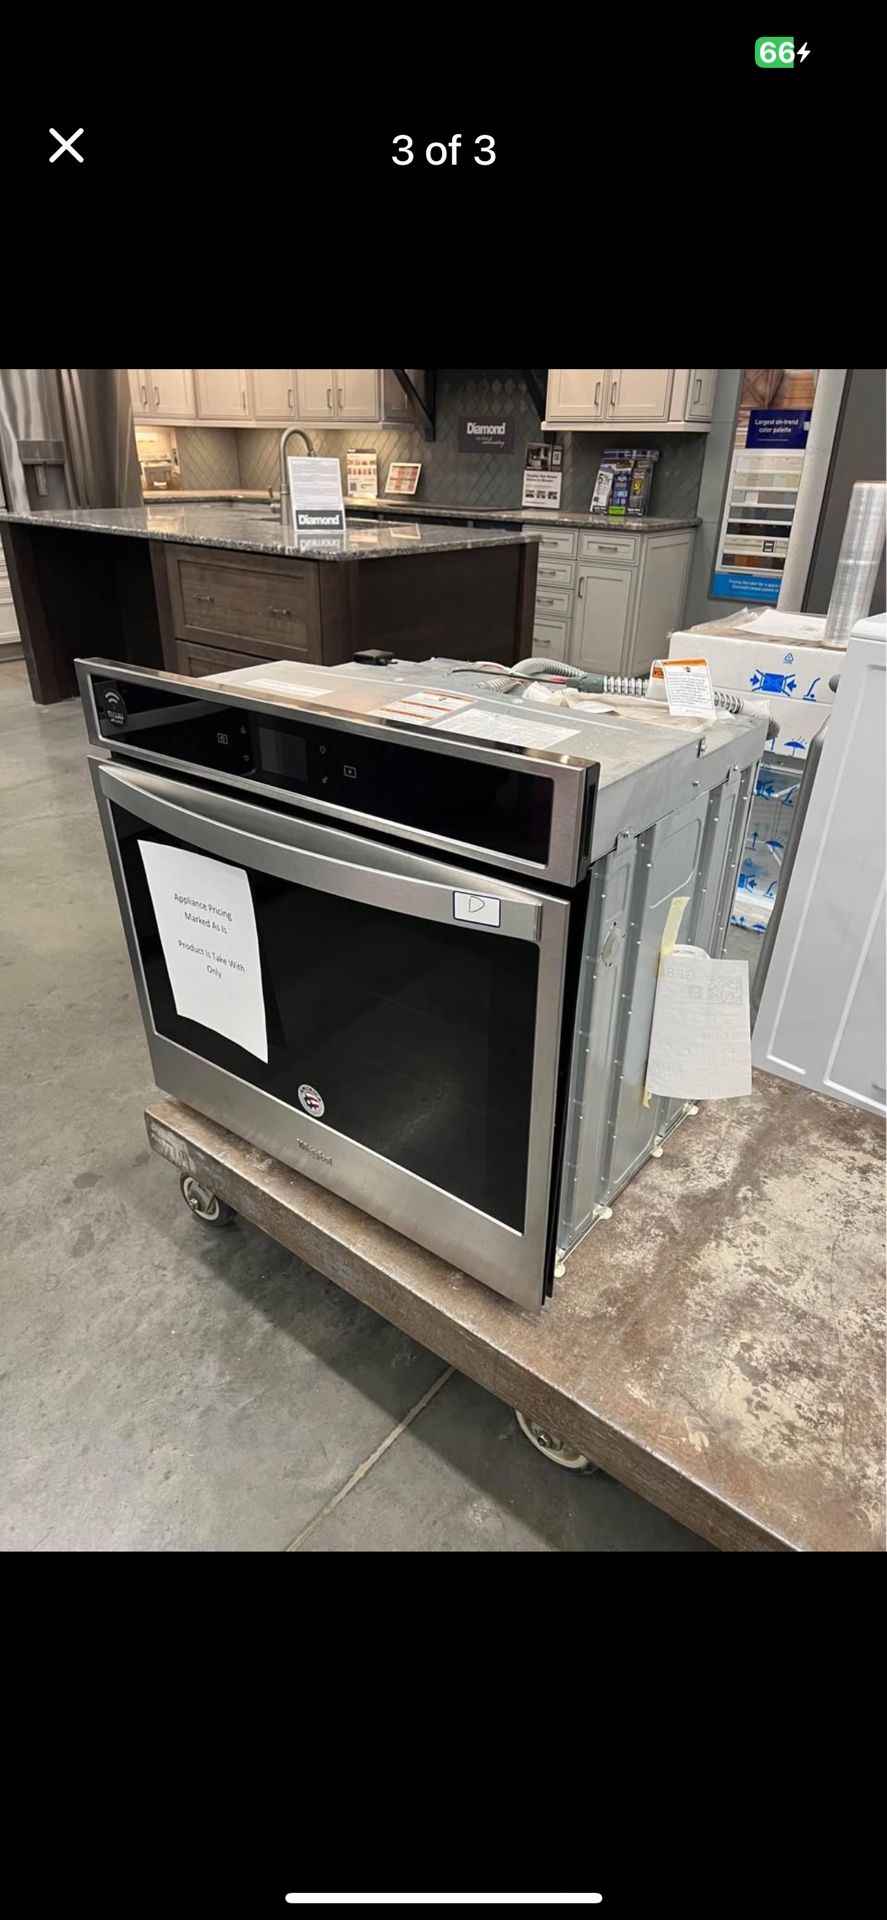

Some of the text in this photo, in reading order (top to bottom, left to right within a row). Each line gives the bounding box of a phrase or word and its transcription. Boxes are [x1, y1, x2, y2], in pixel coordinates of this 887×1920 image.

[467, 421, 506, 435] Diamond
[298, 514, 340, 525] Diamond
[174, 893, 232, 922] Appliance Pricing
[184, 911, 227, 934] Marked As Is
[178, 939, 245, 973] Product Is Take With
[207, 964, 222, 979] Only
